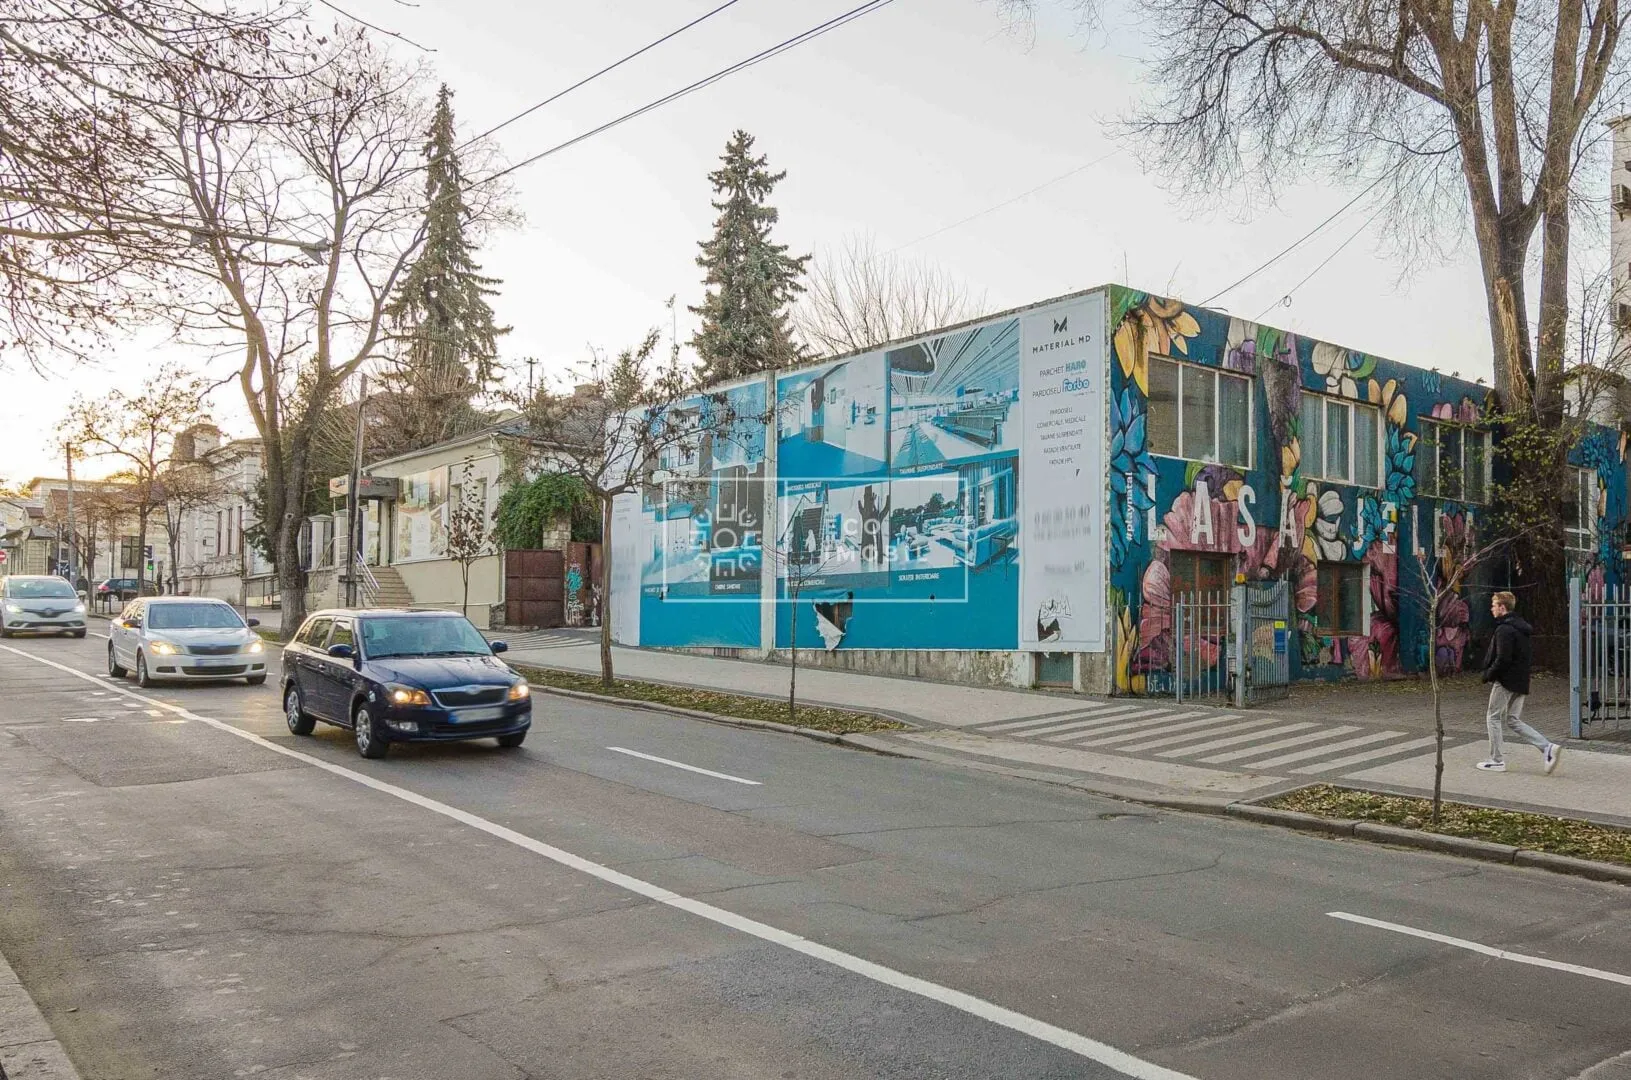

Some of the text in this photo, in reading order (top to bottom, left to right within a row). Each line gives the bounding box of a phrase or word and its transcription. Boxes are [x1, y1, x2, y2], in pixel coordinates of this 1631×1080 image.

[1032, 335, 1091, 354] MATERIAL MD
[1039, 366, 1064, 377] PARCHET
[1065, 360, 1087, 373] HARO
[1032, 386, 1061, 398] PARDOSELI
